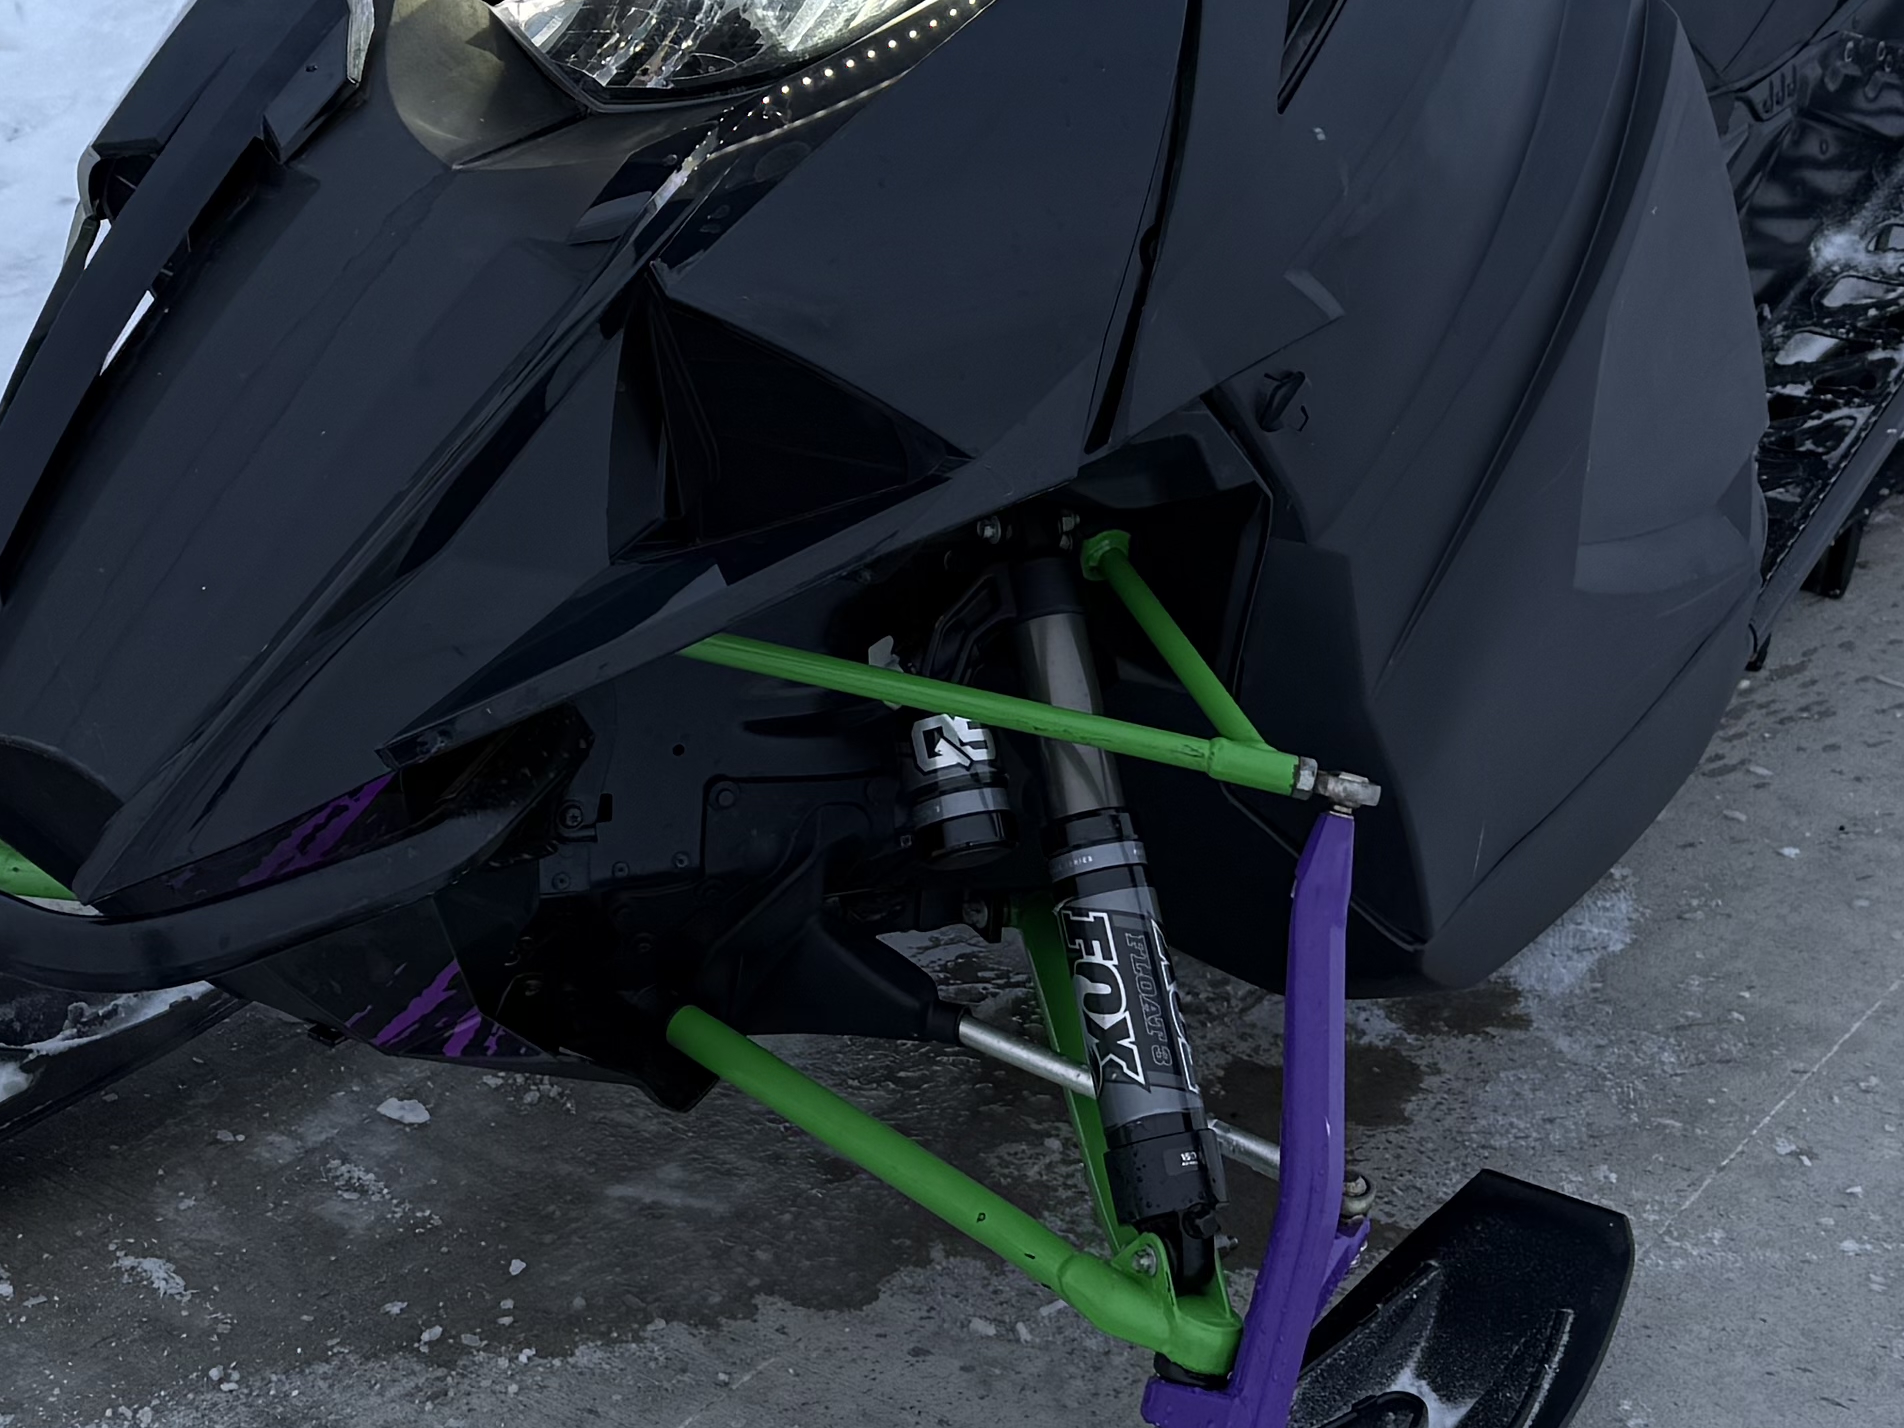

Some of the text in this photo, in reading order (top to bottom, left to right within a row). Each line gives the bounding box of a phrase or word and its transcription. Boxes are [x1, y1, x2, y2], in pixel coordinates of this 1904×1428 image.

[1060, 910, 1146, 1088] FOX
[1125, 932, 1173, 1067] FLOAT 3
